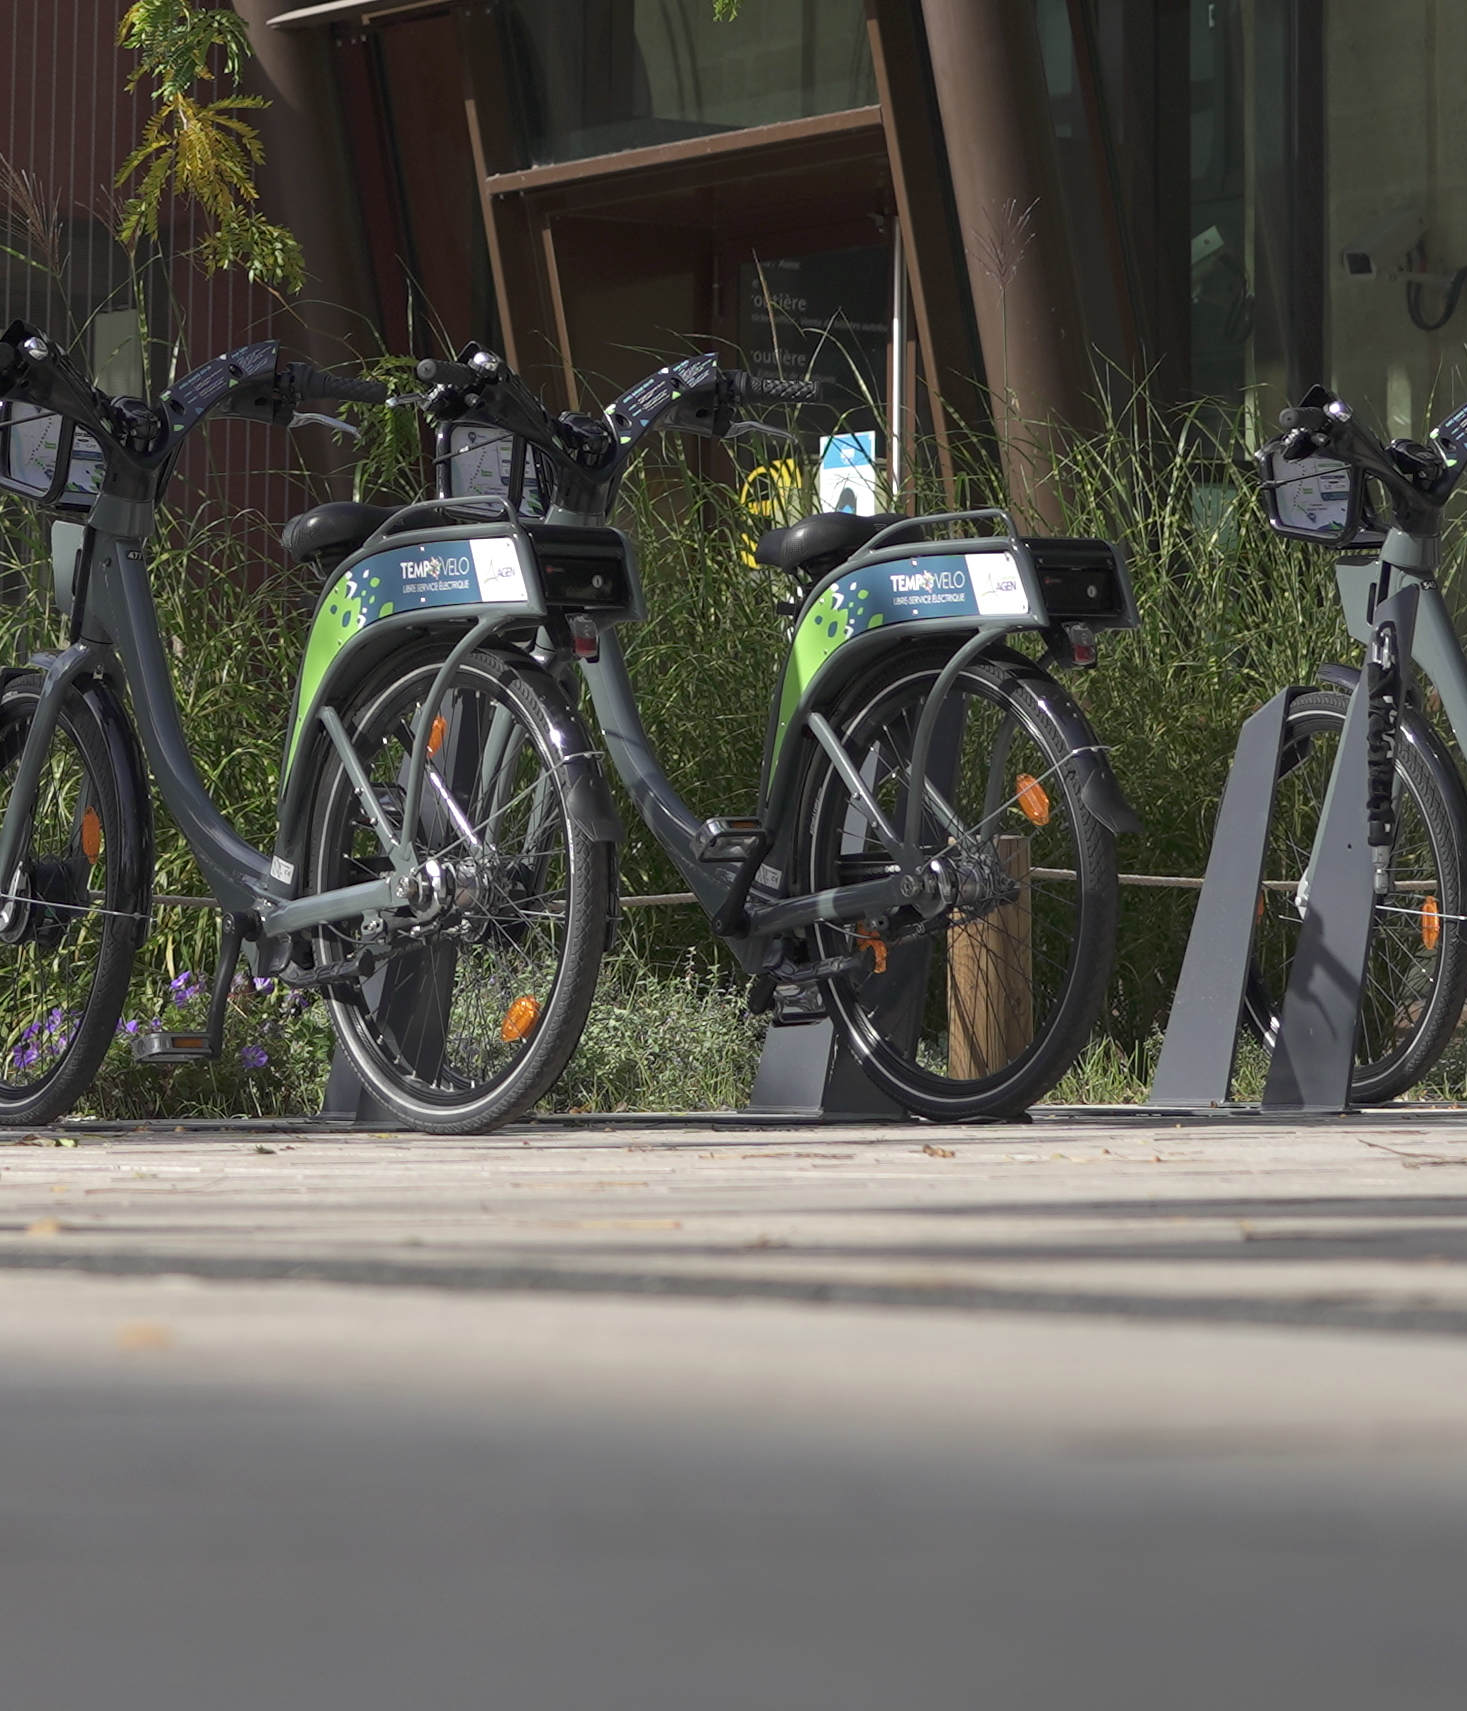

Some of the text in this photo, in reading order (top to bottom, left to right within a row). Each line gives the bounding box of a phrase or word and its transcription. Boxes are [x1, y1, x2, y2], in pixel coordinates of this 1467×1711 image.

[439, 556, 470, 576] VELO
[497, 567, 515, 577] AGEN
[934, 571, 965, 589] VELO
[996, 581, 1017, 591] AGEN
